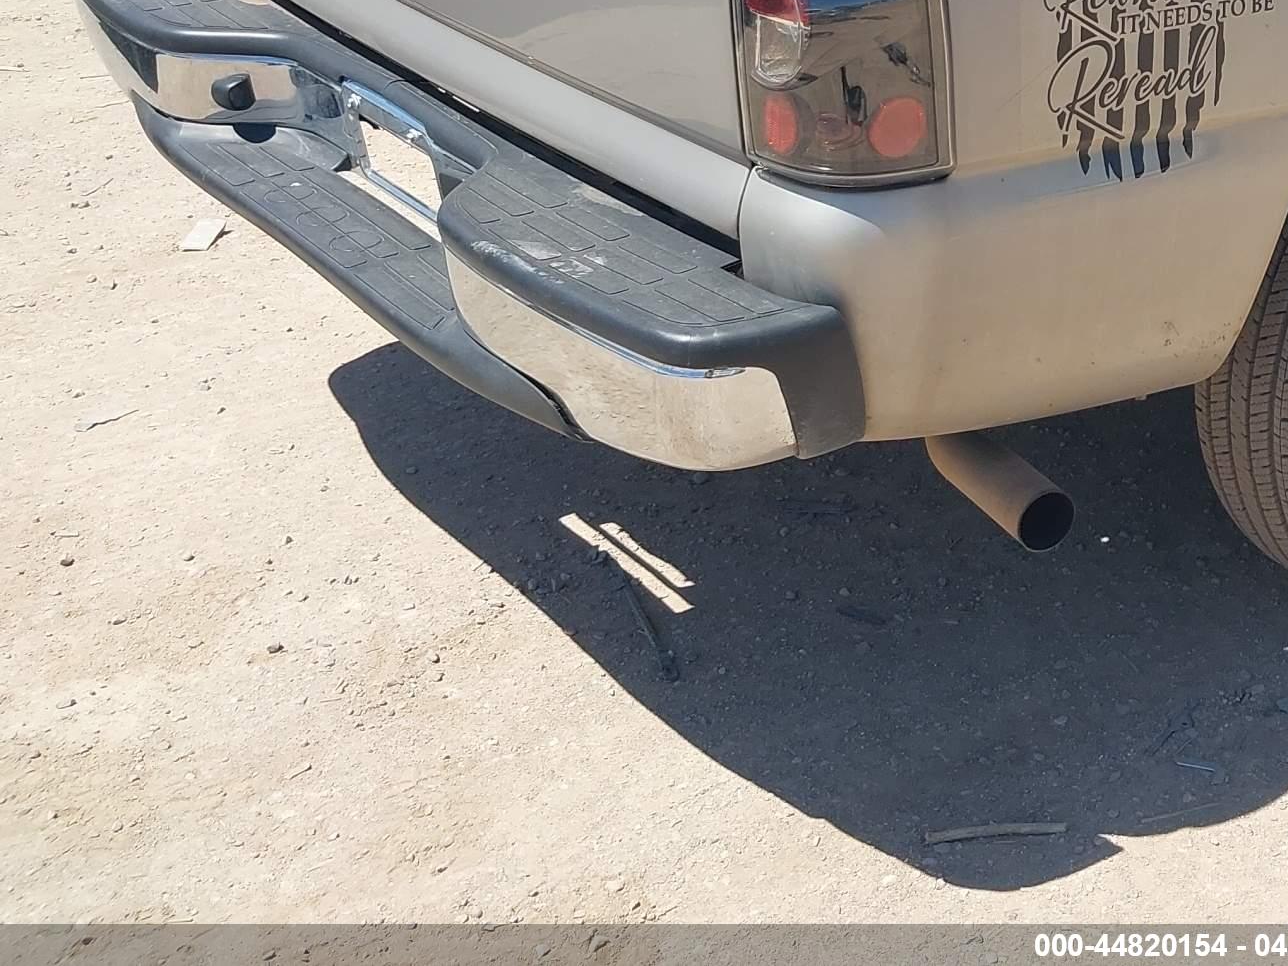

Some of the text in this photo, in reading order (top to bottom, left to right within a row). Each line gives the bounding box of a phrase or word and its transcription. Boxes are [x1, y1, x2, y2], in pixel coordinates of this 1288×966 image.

[1119, 14, 1141, 34] IT
[1145, 2, 1213, 31] NEEDS
[1048, 26, 1217, 139] Reread
